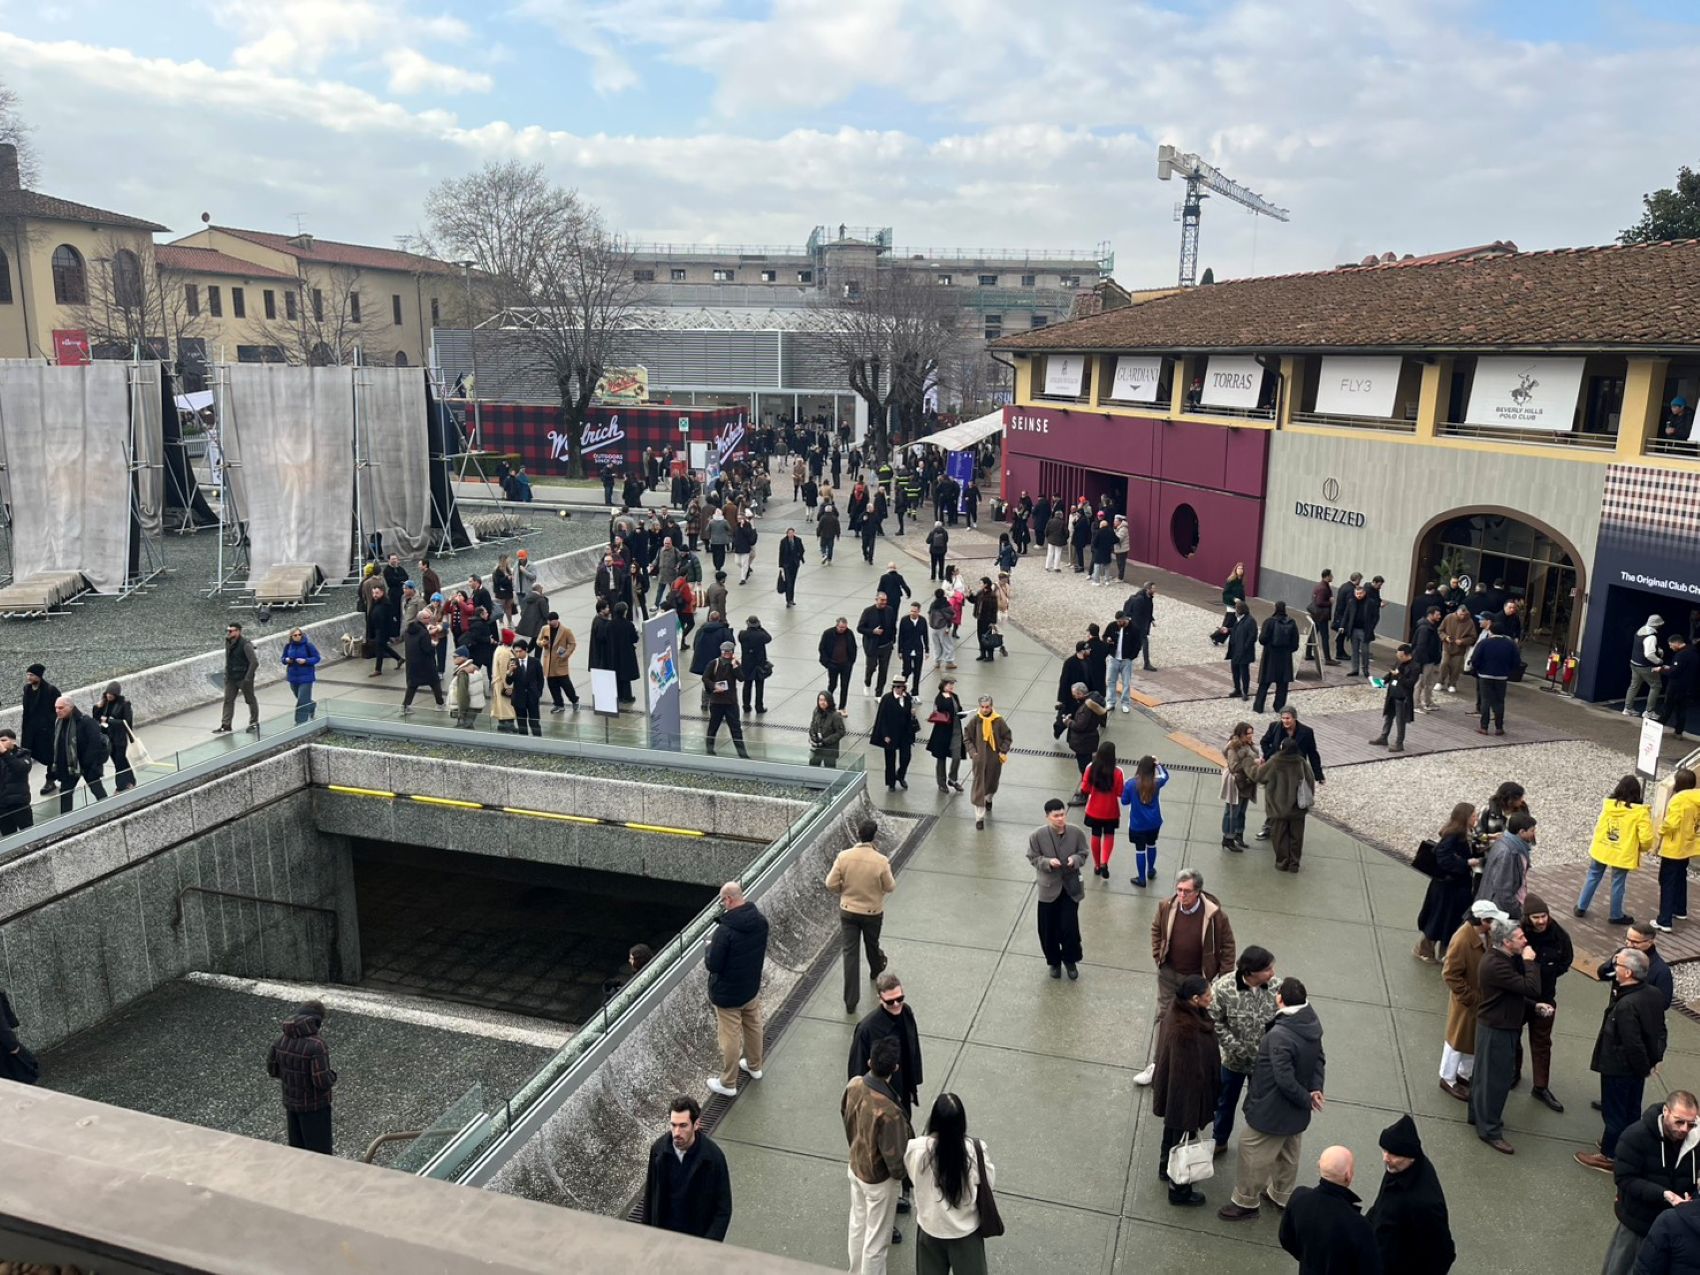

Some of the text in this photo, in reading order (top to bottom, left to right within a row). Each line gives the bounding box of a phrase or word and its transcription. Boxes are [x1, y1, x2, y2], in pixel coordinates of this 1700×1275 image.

[1213, 372, 1253, 390] TORRAS
[1340, 378, 1373, 393] FLY3
[1495, 406, 1524, 414] BEVERLY
[1518, 413, 1536, 421] CLUB
[1011, 415, 1049, 433] SEINSE
[547, 414, 625, 461] Wlrich
[1295, 501, 1366, 528] DSTREZZED
[1620, 571, 1636, 582] The
[1636, 574, 1668, 588] Original
[1668, 580, 1688, 593] Club
